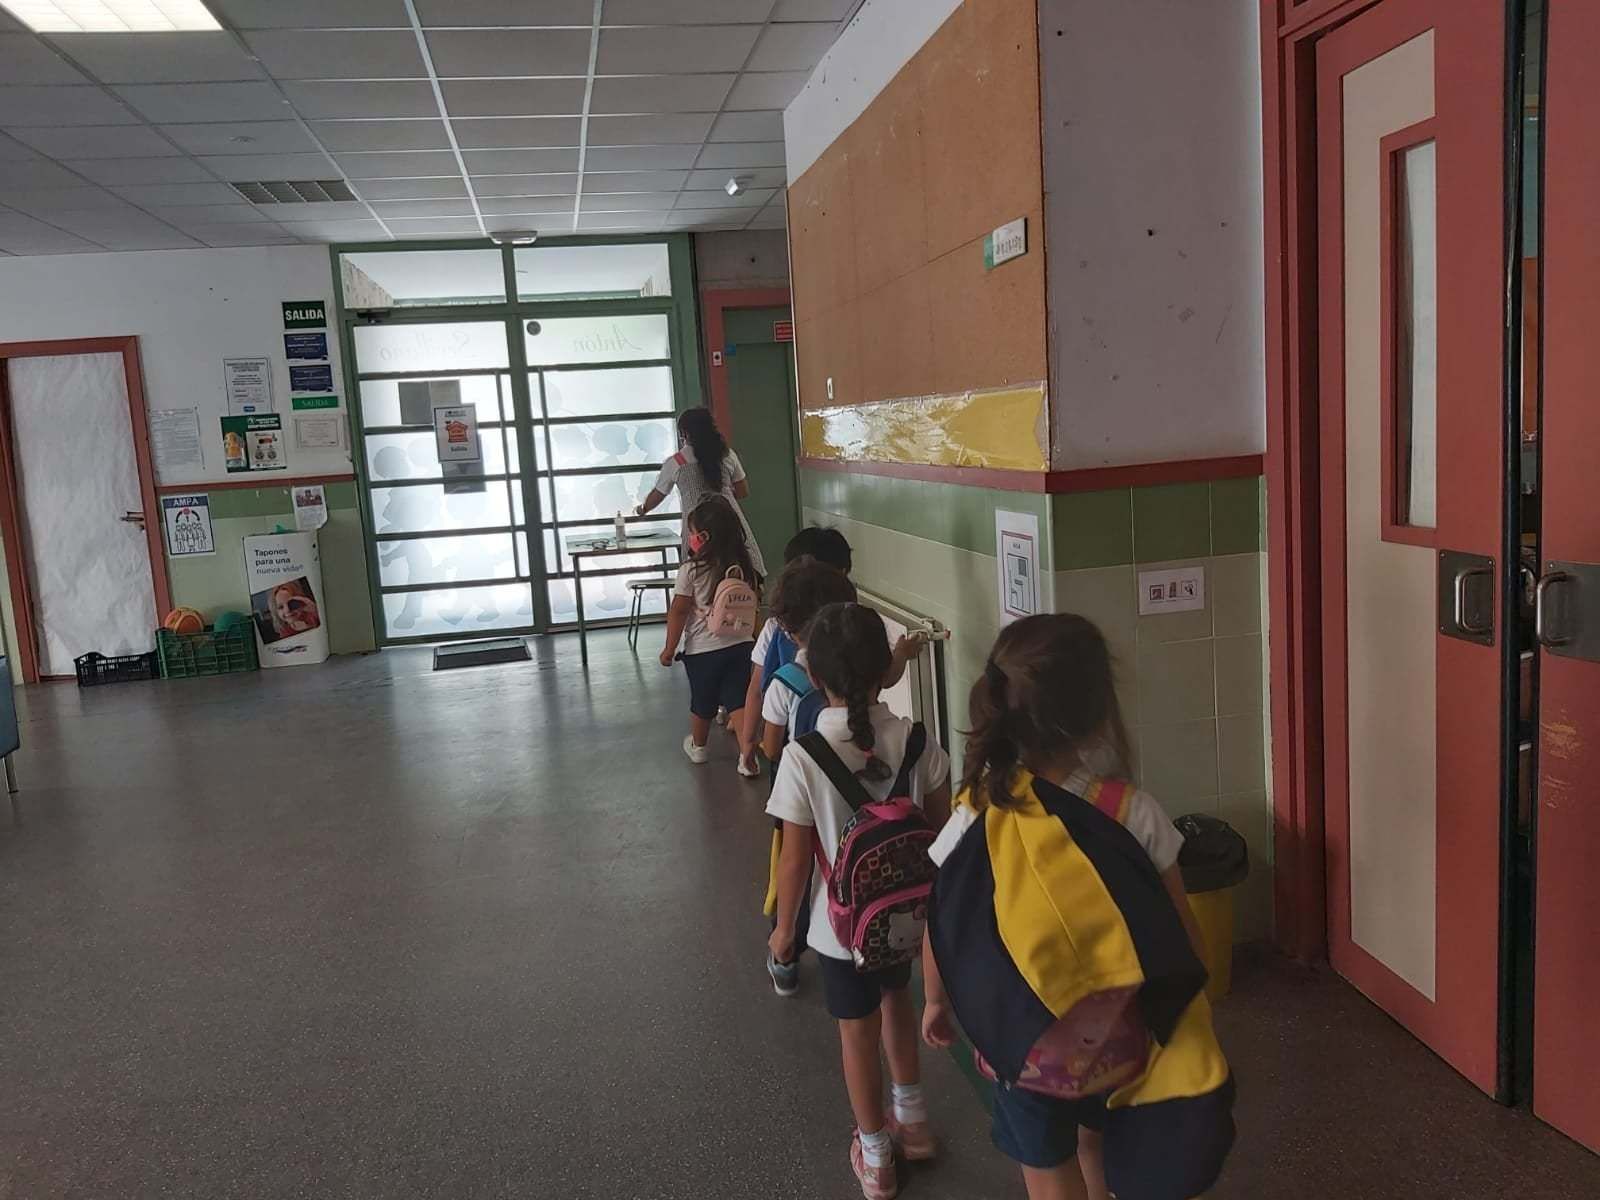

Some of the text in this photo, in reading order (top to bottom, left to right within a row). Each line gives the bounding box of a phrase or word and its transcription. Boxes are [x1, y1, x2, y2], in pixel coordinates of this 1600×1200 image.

[284, 309, 325, 321] SALIDA
[173, 497, 199, 506] AMPA
[254, 549, 288, 557] Tapones
